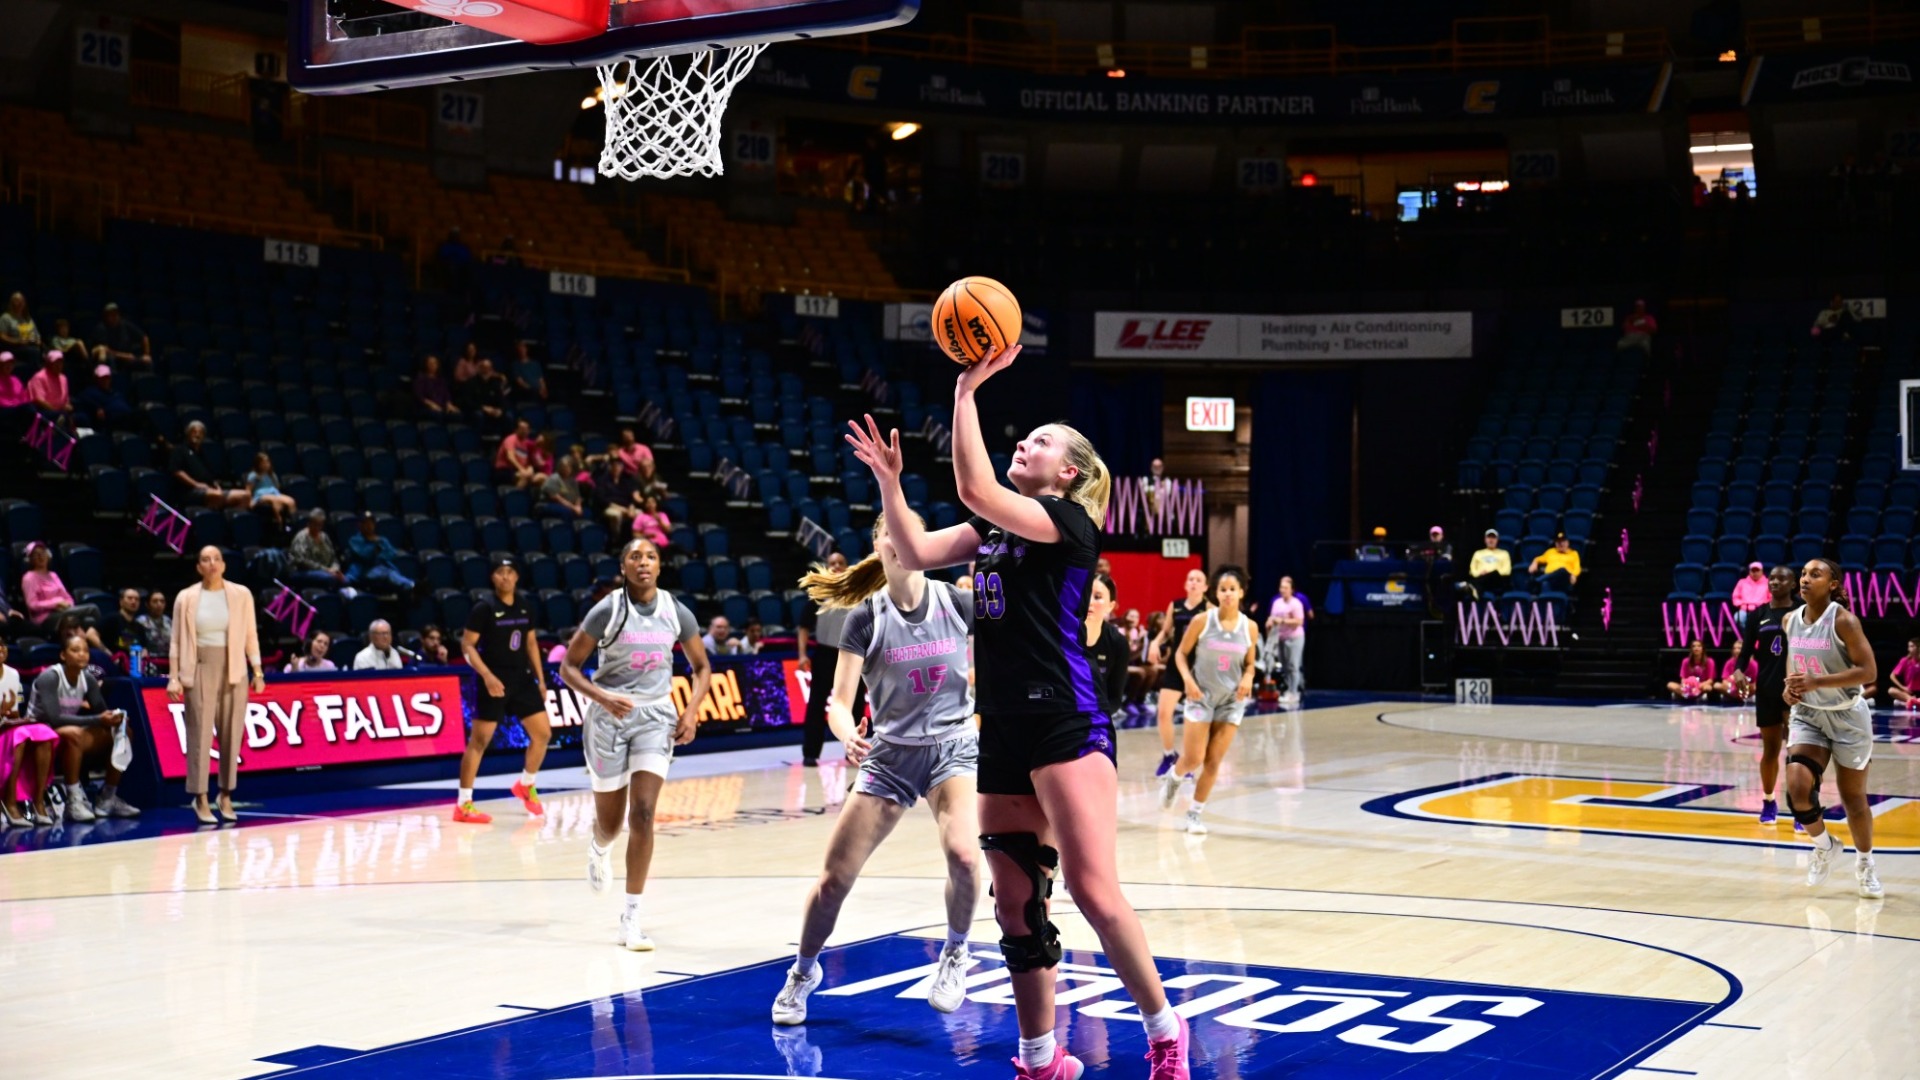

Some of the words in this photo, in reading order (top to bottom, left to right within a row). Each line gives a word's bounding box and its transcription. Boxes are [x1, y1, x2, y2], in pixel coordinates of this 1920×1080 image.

[82, 32, 122, 67] 216
[442, 94, 478, 123] 217
[1020, 88, 1108, 112] OFFICIAL
[1116, 92, 1209, 114] BANKING
[1217, 94, 1315, 115] PARTNER
[1350, 95, 1423, 115] FirstBank
[1541, 88, 1616, 108] FirstBank
[986, 156, 1021, 181] 219
[1242, 161, 1278, 186] 219
[1515, 154, 1555, 178] 220
[275, 243, 308, 263] 115
[559, 275, 587, 293] 116
[1571, 308, 1605, 325] 120
[1153, 319, 1213, 341] LEE
[1261, 322, 1317, 336] Heating
[1330, 323, 1350, 333] Air
[1355, 320, 1452, 335] Conditioning
[1261, 339, 1330, 353] Plumbing
[1343, 338, 1409, 350] Electrical
[1191, 402, 1229, 426] EXIT
[974, 572, 1006, 619] 33
[509, 630, 522, 651] 0
[885, 637, 958, 664] CHATTANOOGA
[1770, 635, 1783, 656] 4
[629, 651, 665, 671] 22
[1217, 655, 1232, 671] 5
[1793, 654, 1822, 674] 34
[907, 664, 948, 694] 15
[1458, 681, 1489, 695] 120
[313, 692, 444, 743] FALLS
